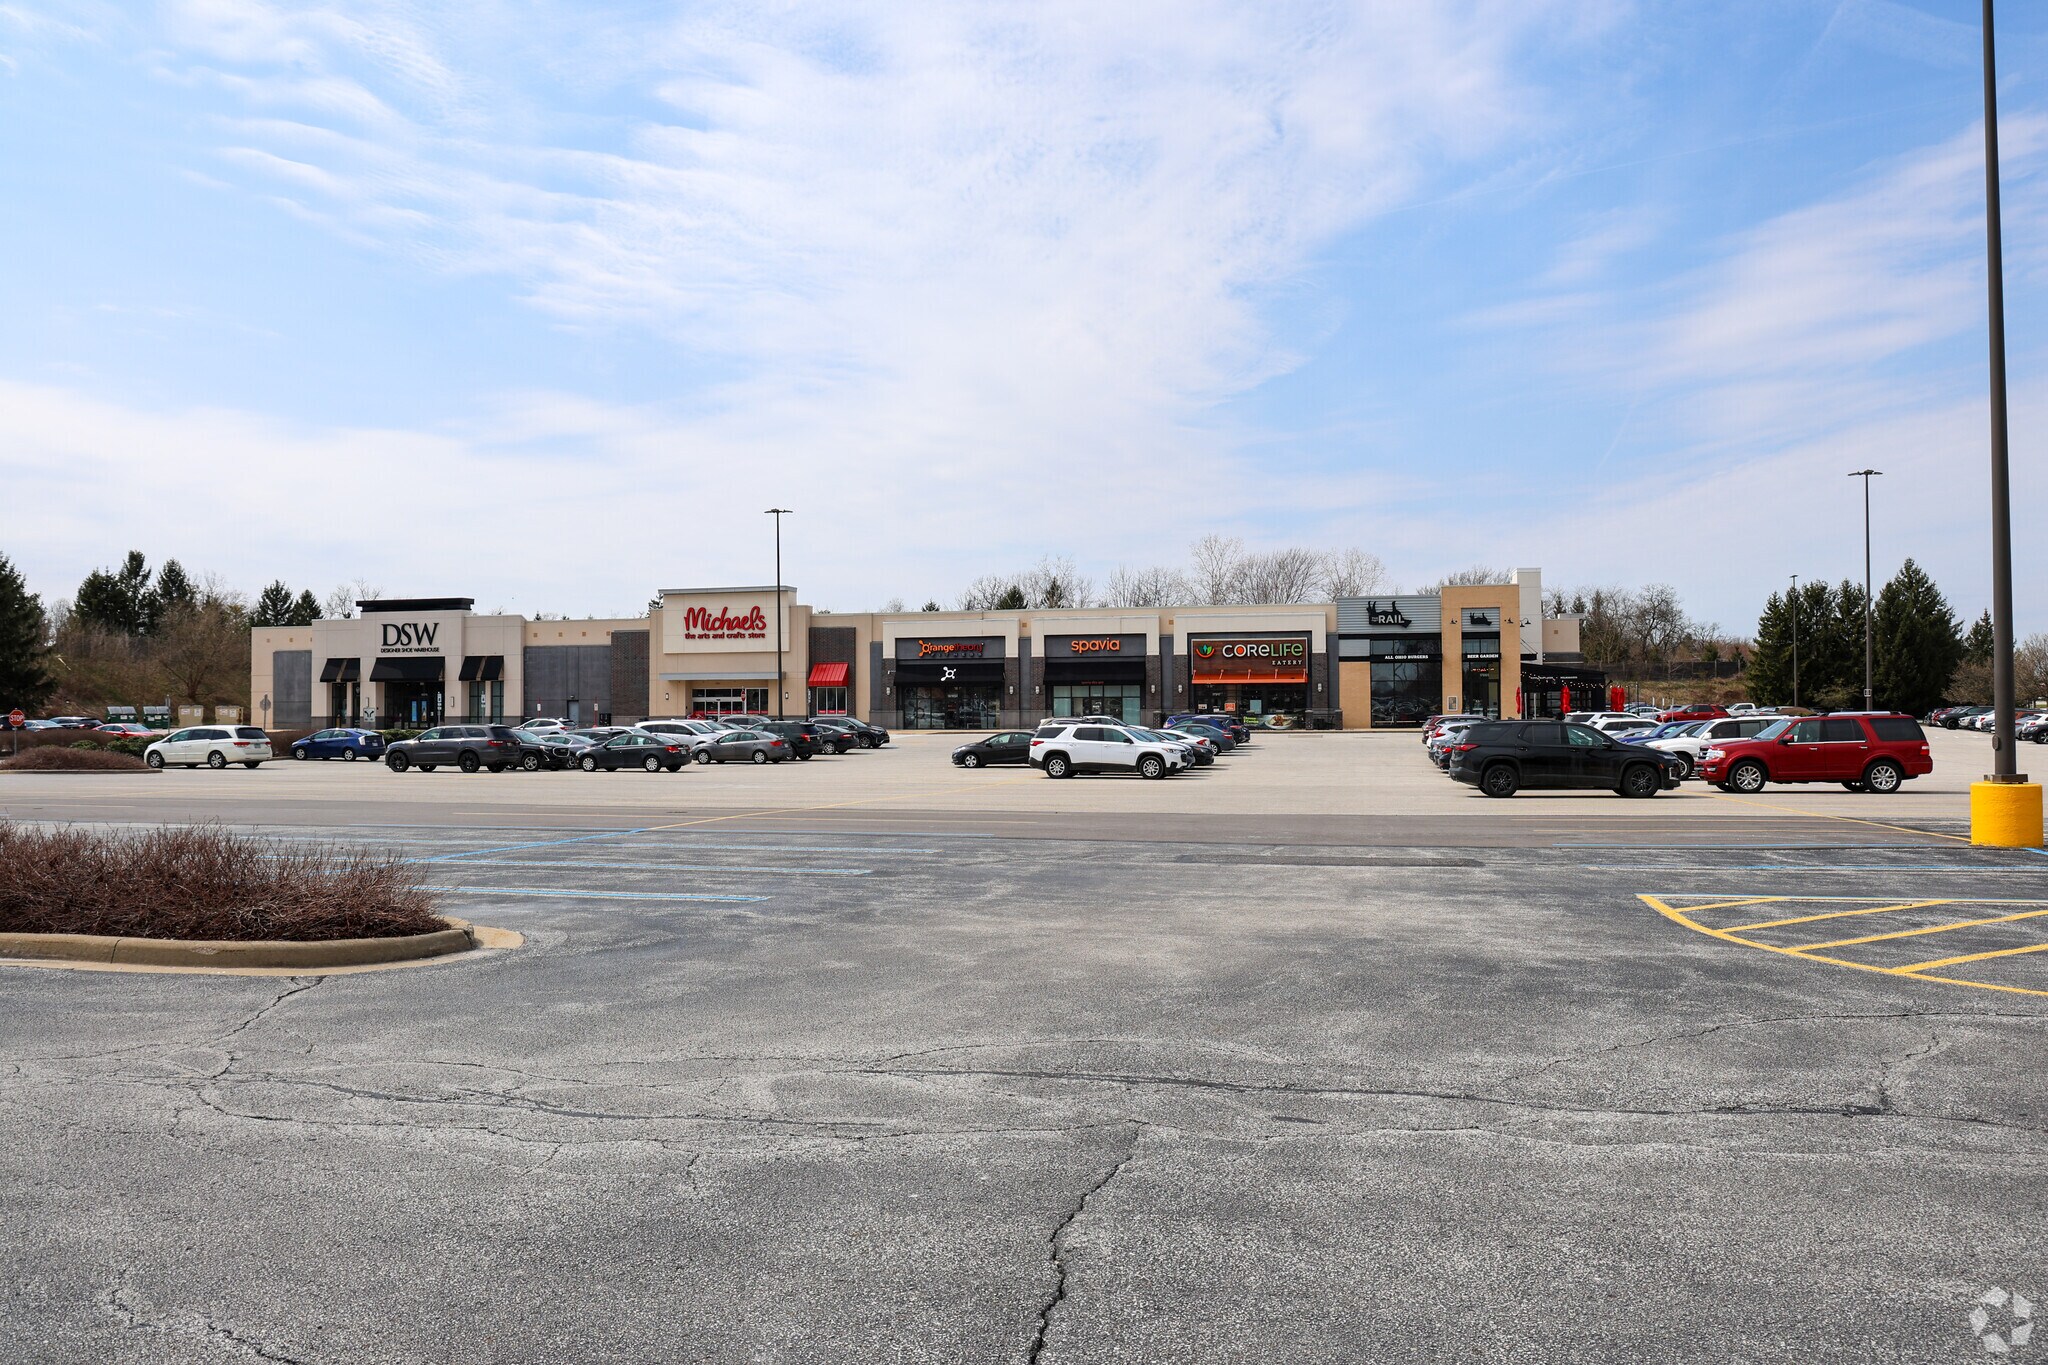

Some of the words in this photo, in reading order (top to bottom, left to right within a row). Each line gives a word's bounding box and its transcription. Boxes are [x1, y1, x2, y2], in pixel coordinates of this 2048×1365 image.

[684, 605, 767, 631] Michaels
[1378, 614, 1405, 624] RAIL
[381, 622, 440, 646] DSW
[1071, 637, 1120, 654] spavia
[10, 714, 24, 722] STOP
